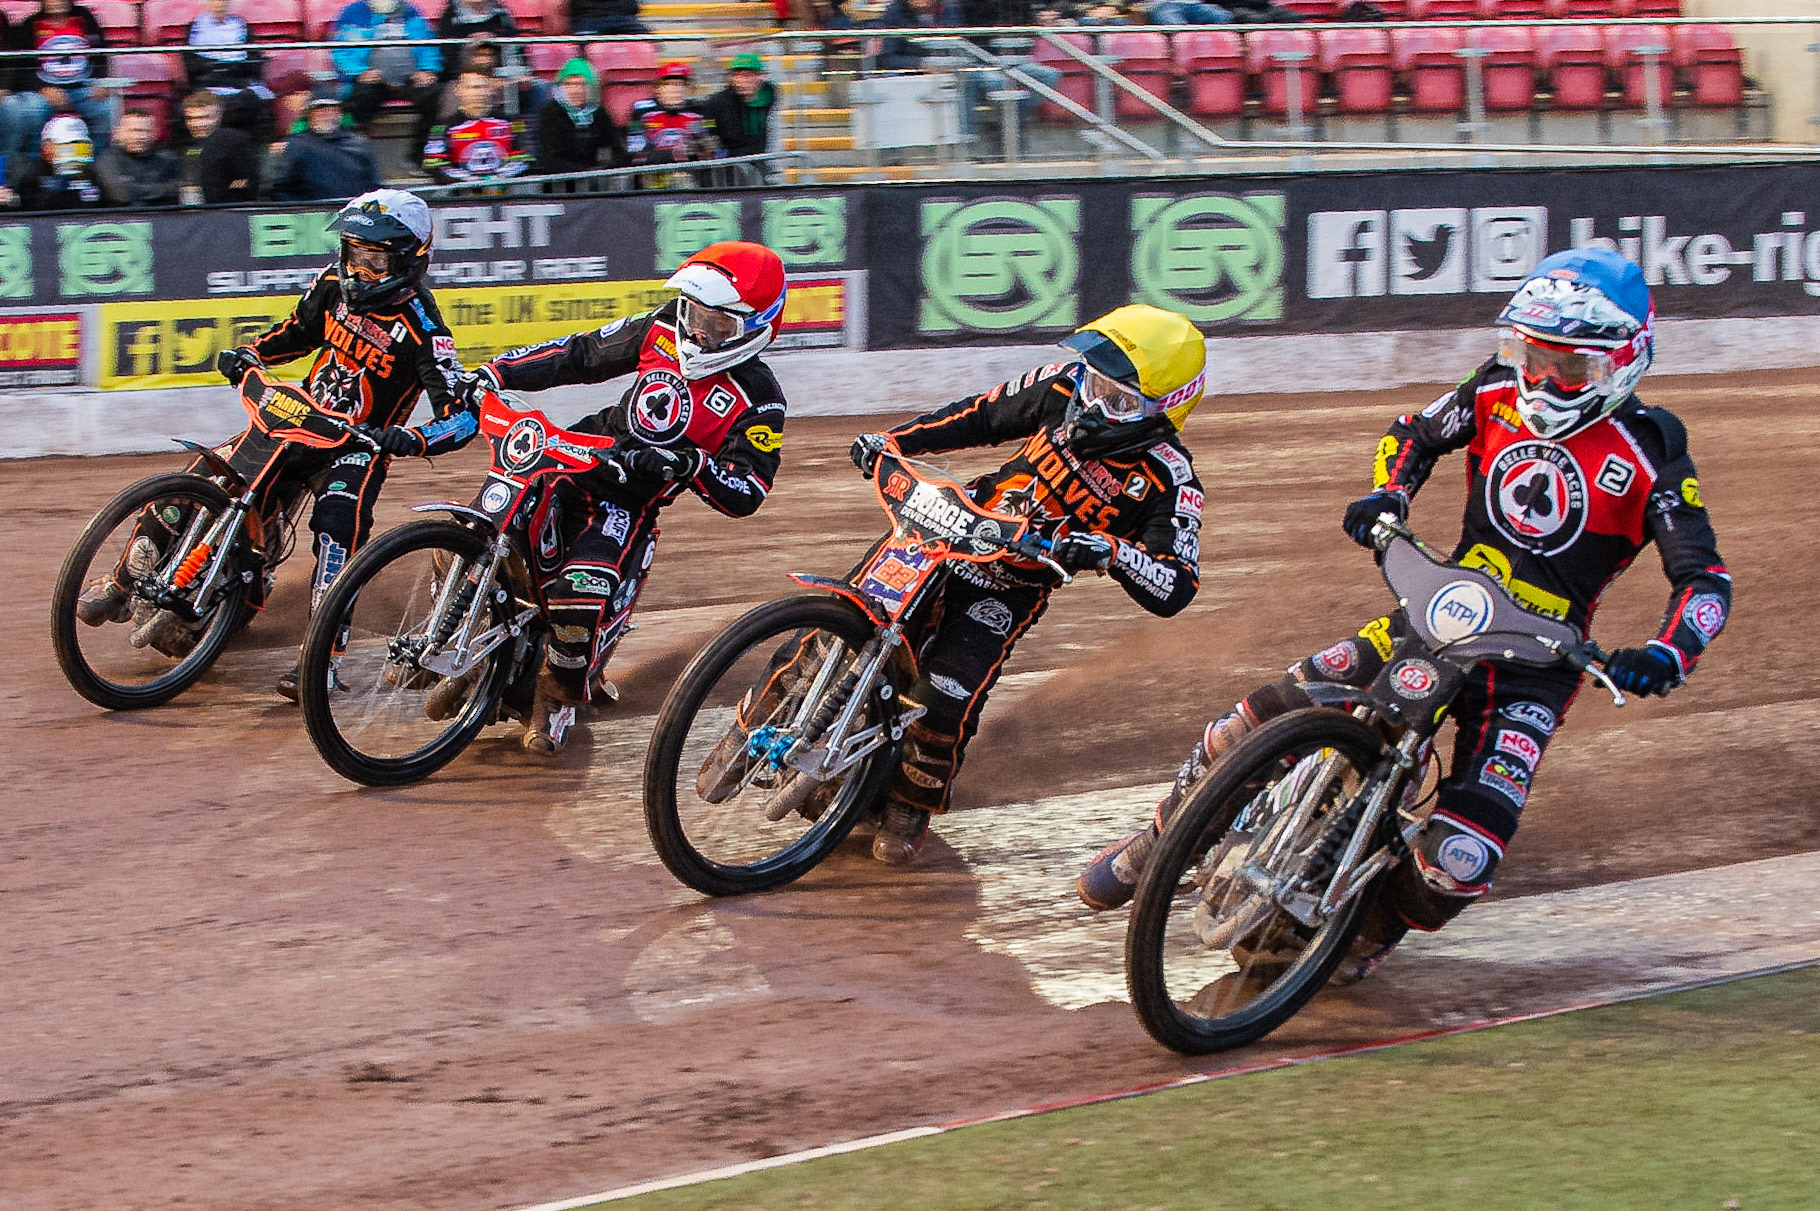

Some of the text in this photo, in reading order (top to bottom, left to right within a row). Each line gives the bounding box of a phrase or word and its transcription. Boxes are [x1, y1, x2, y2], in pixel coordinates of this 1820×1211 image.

[323, 310, 396, 378] WOLVES
[645, 369, 672, 384] BELLE
[710, 390, 727, 412] 6
[1023, 425, 1120, 531] WOLVES
[1125, 476, 1146, 498] 2
[1496, 445, 1583, 509] BELLE VUE ACES
[1605, 459, 1630, 490] 2
[905, 480, 976, 536] BORGE
[1440, 599, 1479, 626] ATPI
